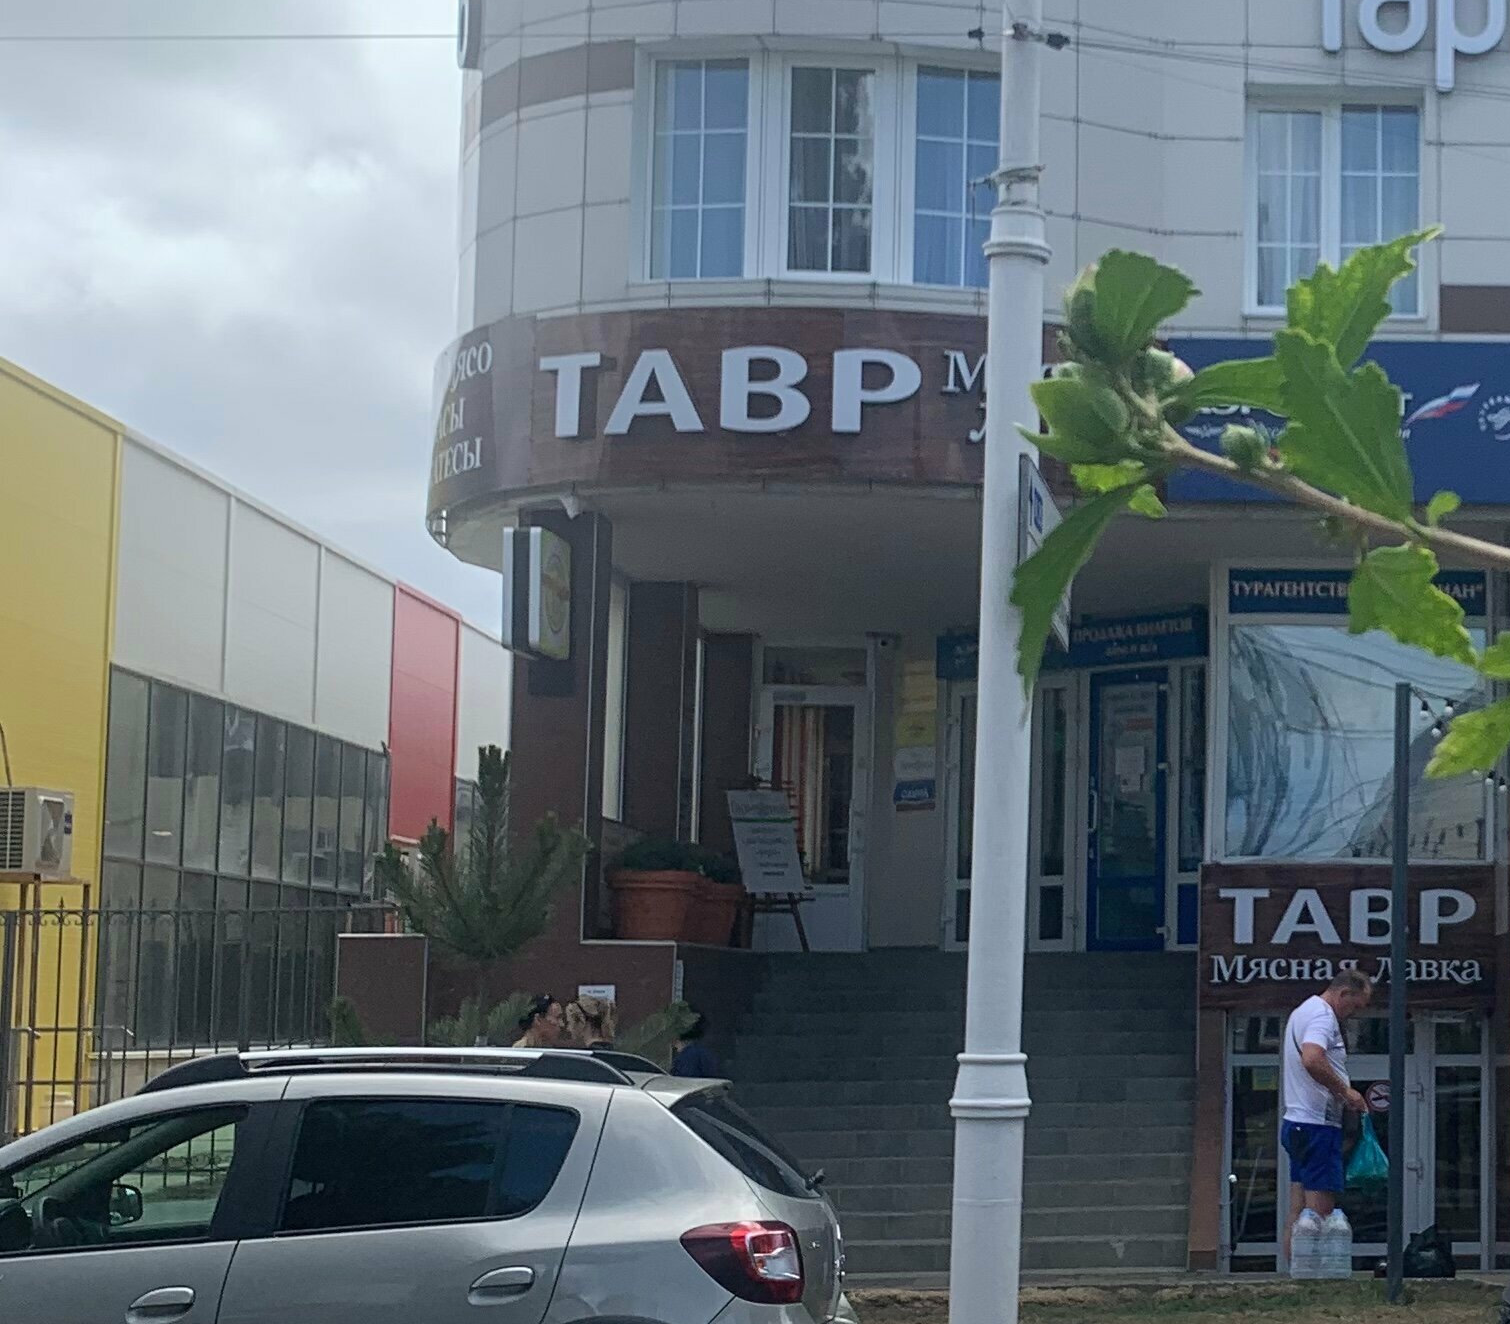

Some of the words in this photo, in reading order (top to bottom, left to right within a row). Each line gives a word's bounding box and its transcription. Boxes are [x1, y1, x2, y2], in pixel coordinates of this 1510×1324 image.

[539, 345, 921, 439] ТАВР
[1232, 579, 1350, 598] ТУРАГЕНТСТВ
[1218, 888, 1477, 945] ТАВР
